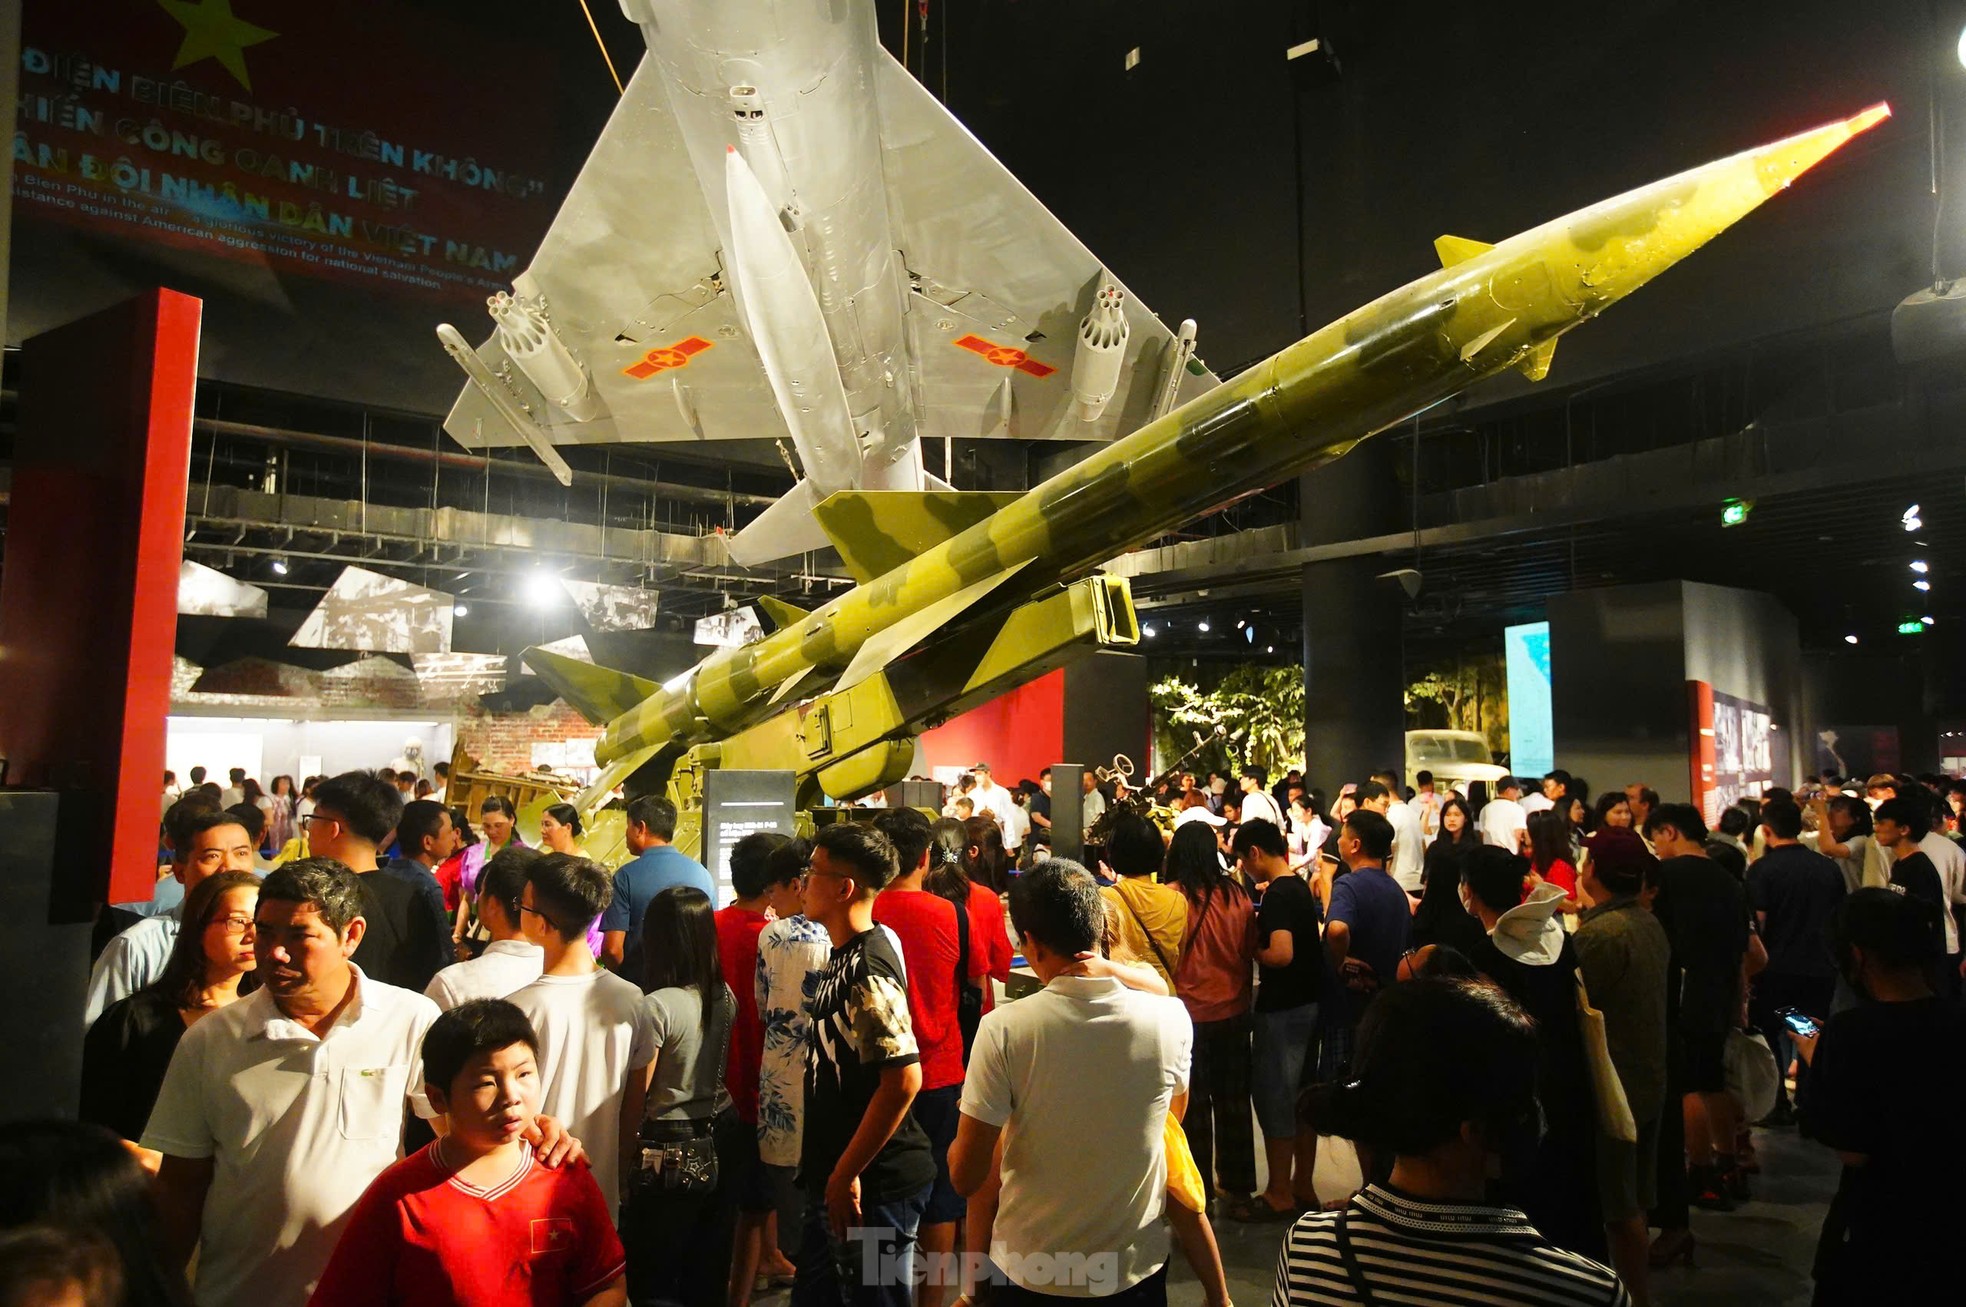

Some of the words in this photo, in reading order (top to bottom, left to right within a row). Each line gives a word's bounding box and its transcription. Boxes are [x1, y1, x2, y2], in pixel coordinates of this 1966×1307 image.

[115, 117, 225, 165] CÔNG
[235, 147, 339, 195] OANH
[347, 174, 421, 210] LIỆT
[313, 122, 405, 168] TRÊN
[23, 173, 61, 191] Bien
[66, 183, 98, 200] Phu
[103, 194, 117, 205] in
[122, 196, 146, 211] the
[150, 204, 170, 217] air
[269, 231, 317, 251] victory
[320, 242, 334, 254] of
[338, 246, 359, 260] the
[361, 251, 416, 272] Vietnam
[79, 153, 151, 194] ĐỘI
[161, 172, 270, 220] NHÂN
[279, 200, 354, 239] DÂN
[361, 218, 438, 257] VIỆT
[445, 239, 518, 274] NAM
[80, 203, 139, 223] against
[142, 215, 214, 240] American
[217, 233, 298, 258] aggression
[301, 250, 321, 263] for
[324, 257, 379, 276] national
[382, 269, 441, 289] salvation
